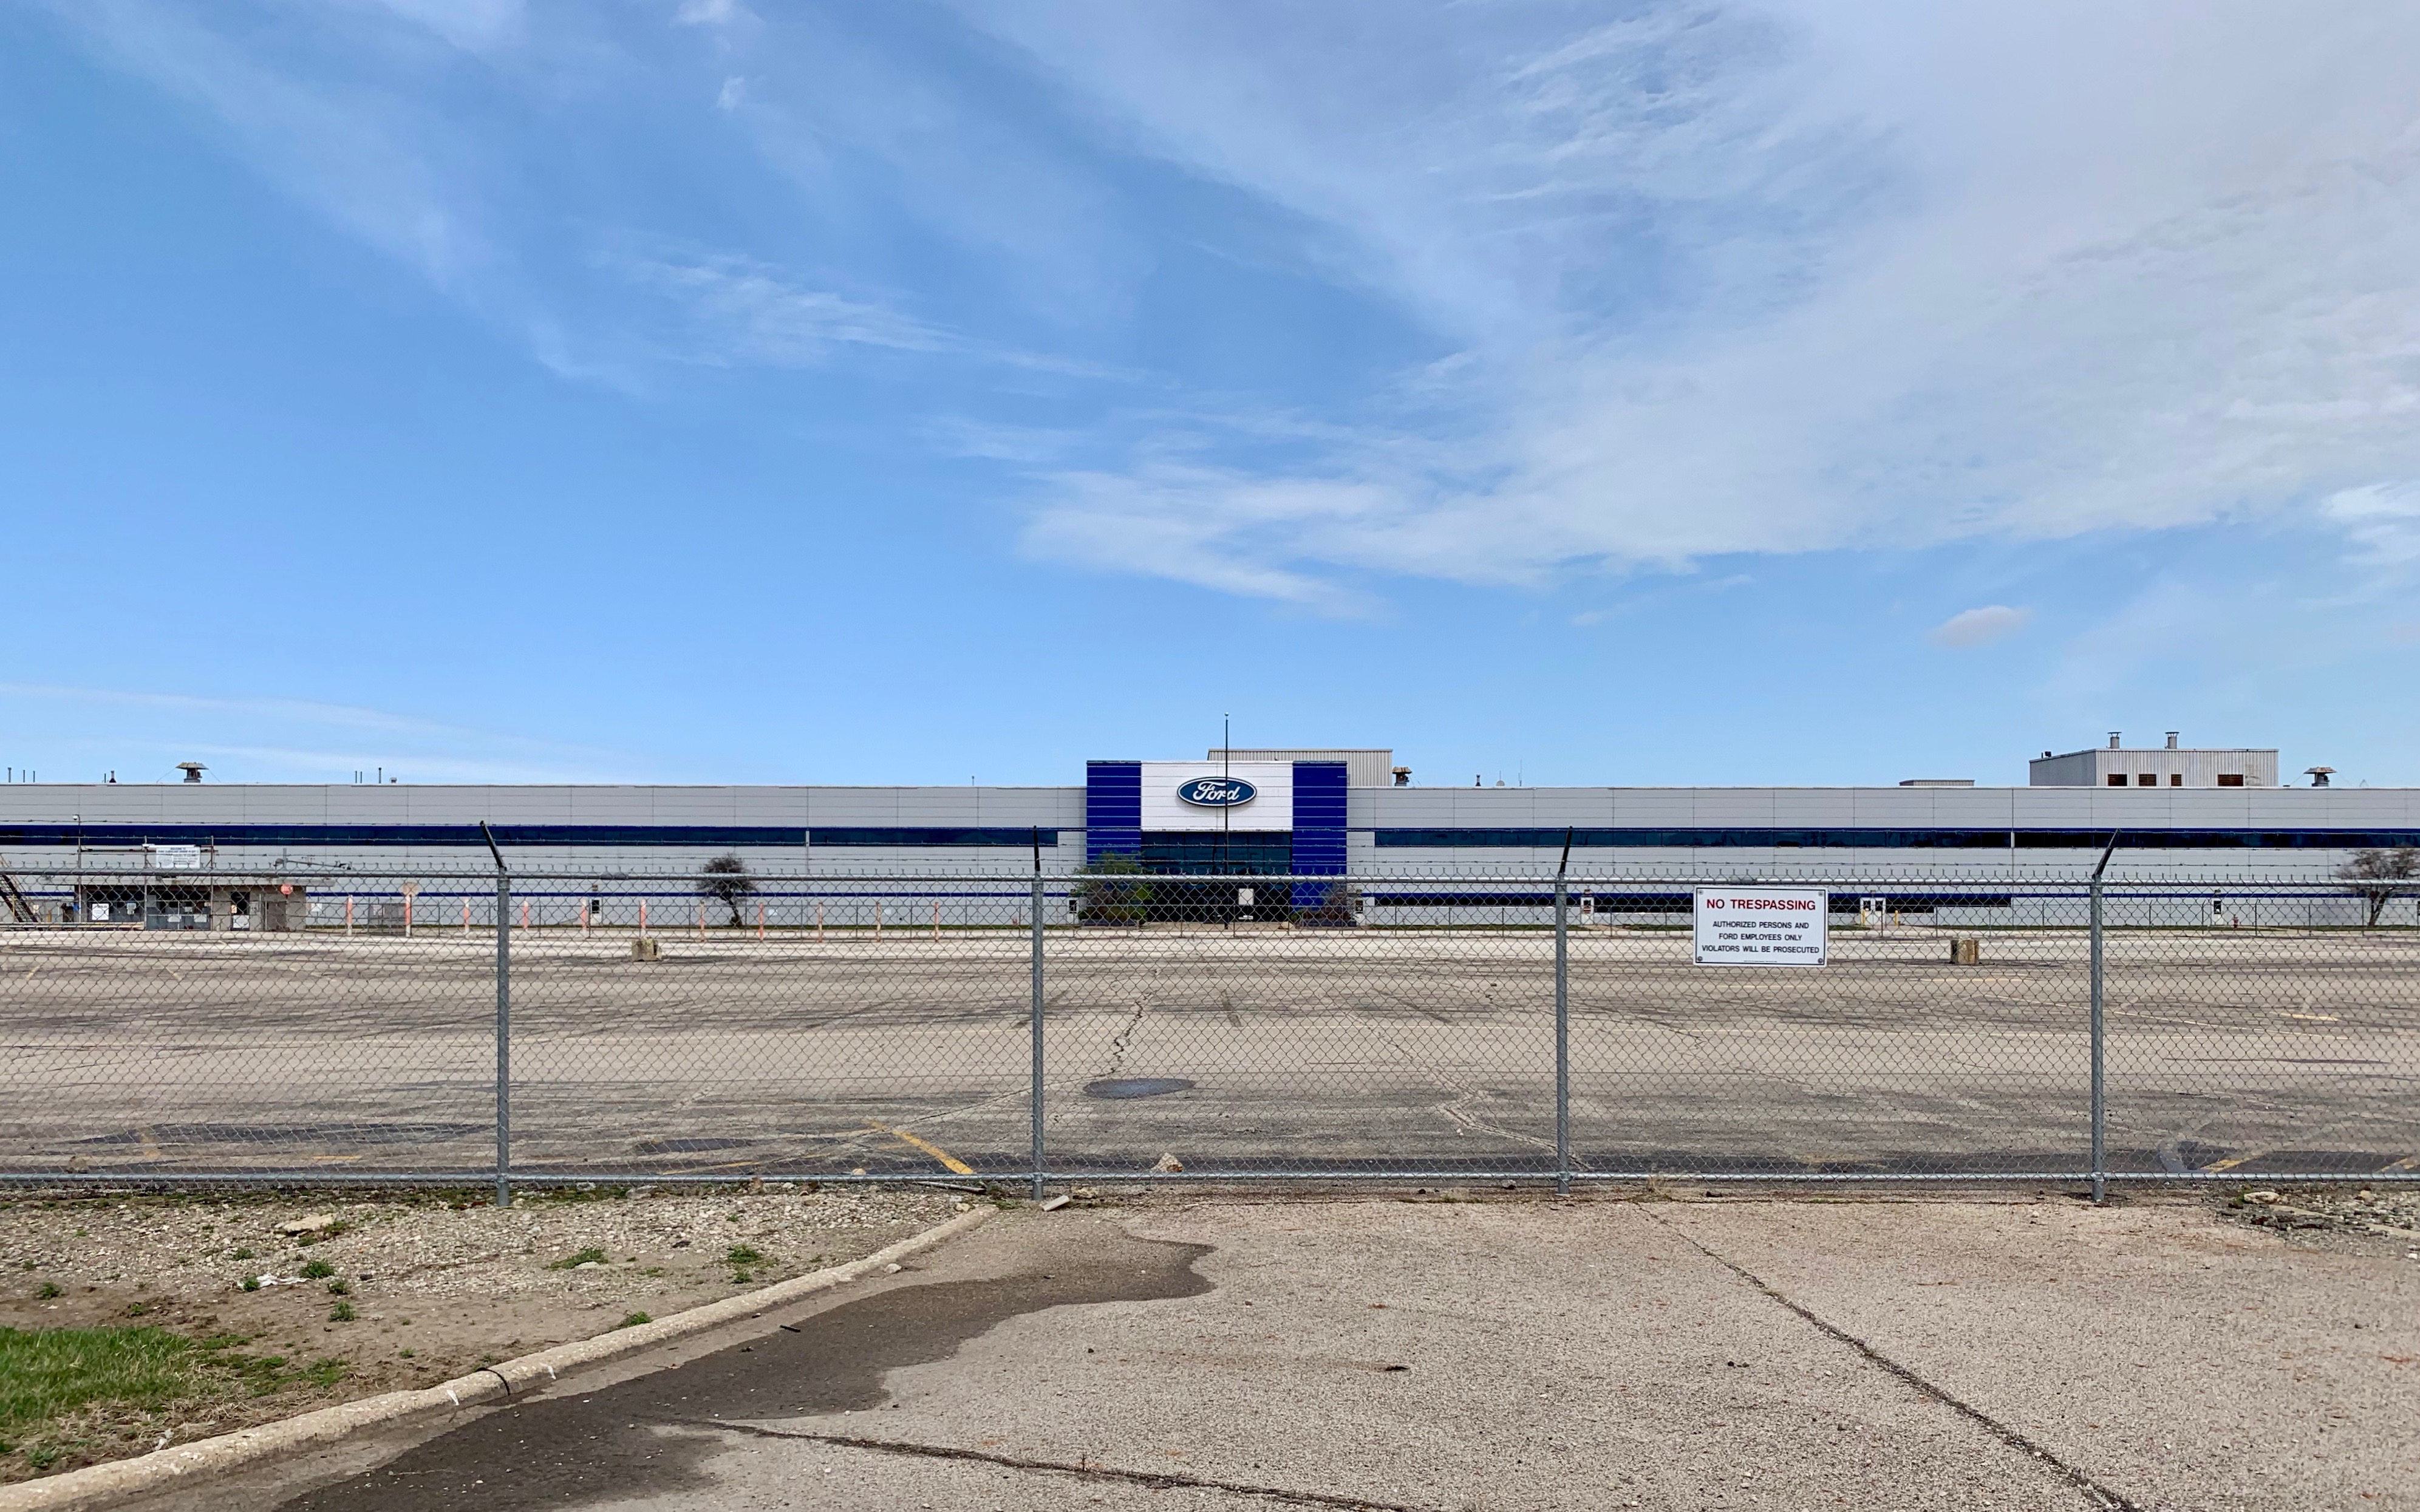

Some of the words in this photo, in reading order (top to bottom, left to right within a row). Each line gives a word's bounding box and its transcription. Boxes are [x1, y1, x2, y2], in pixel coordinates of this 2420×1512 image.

[1193, 781, 1241, 801] Ford
[1707, 899, 1725, 909] NO
[1730, 899, 1815, 910] TRESPASSING
